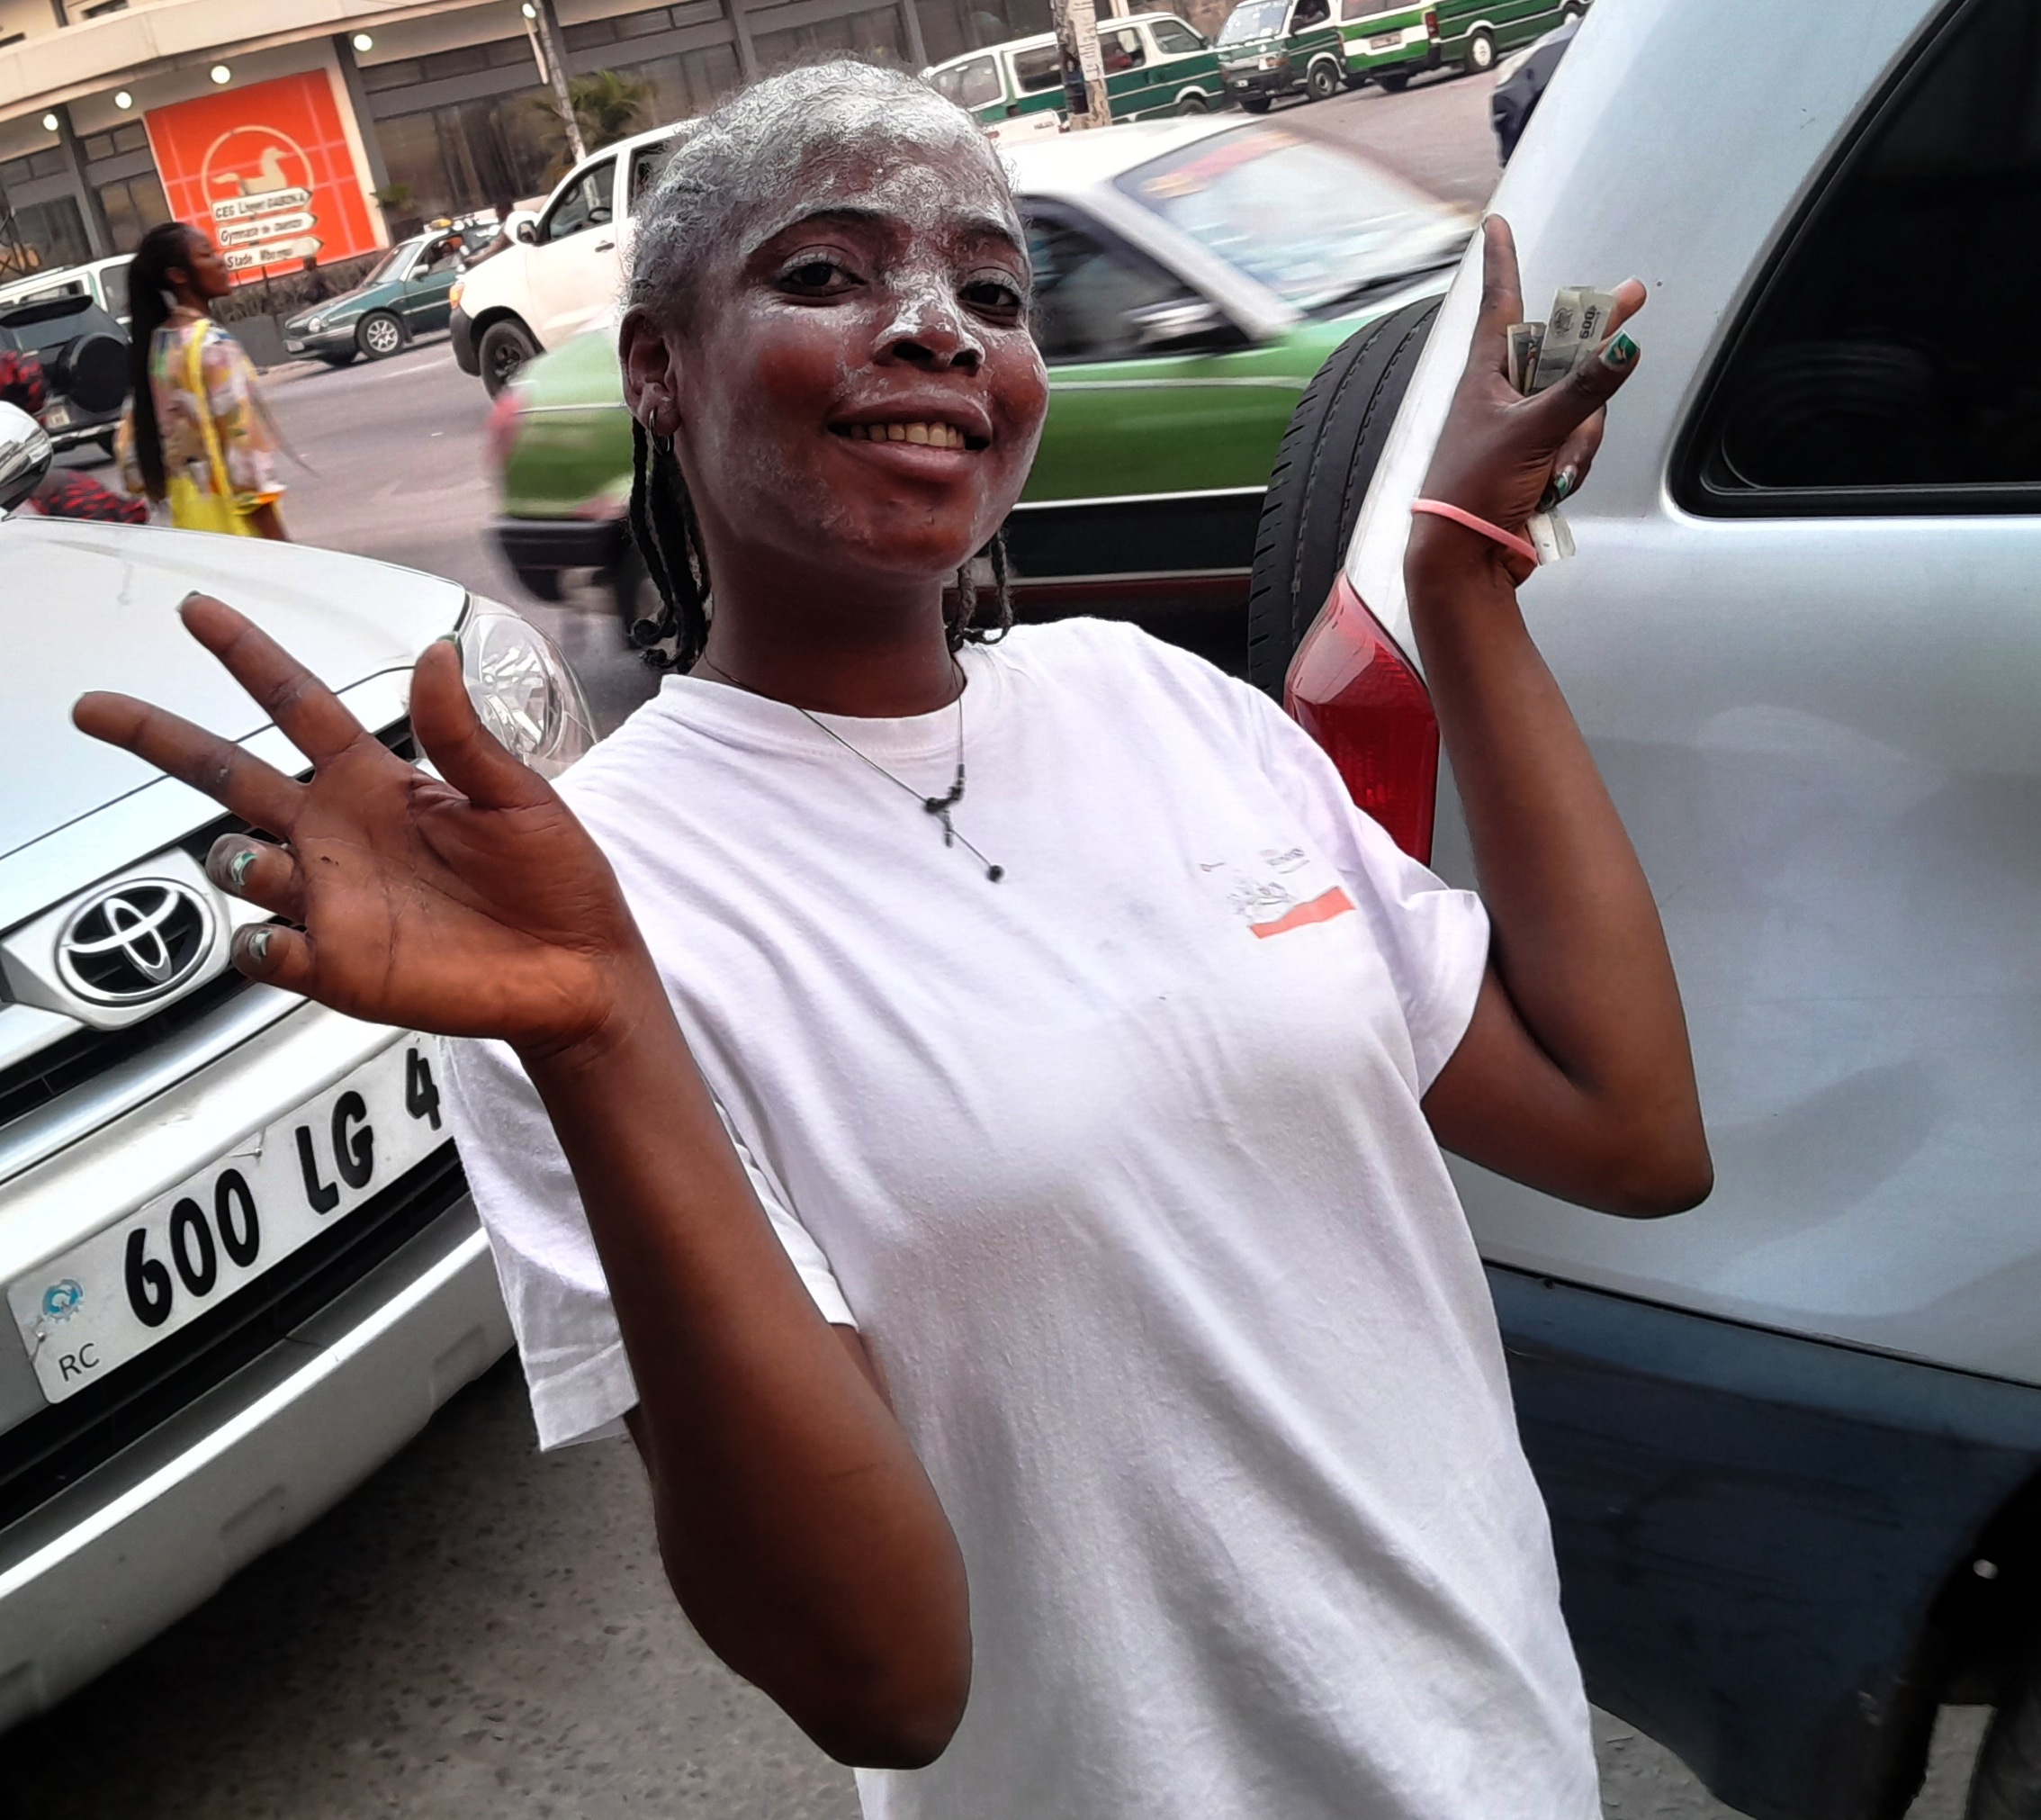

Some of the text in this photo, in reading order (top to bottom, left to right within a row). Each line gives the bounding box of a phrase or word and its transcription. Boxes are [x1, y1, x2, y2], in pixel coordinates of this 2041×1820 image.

[125, 1048, 442, 1328] 600 LG 4
[58, 1343, 100, 1382] RC
